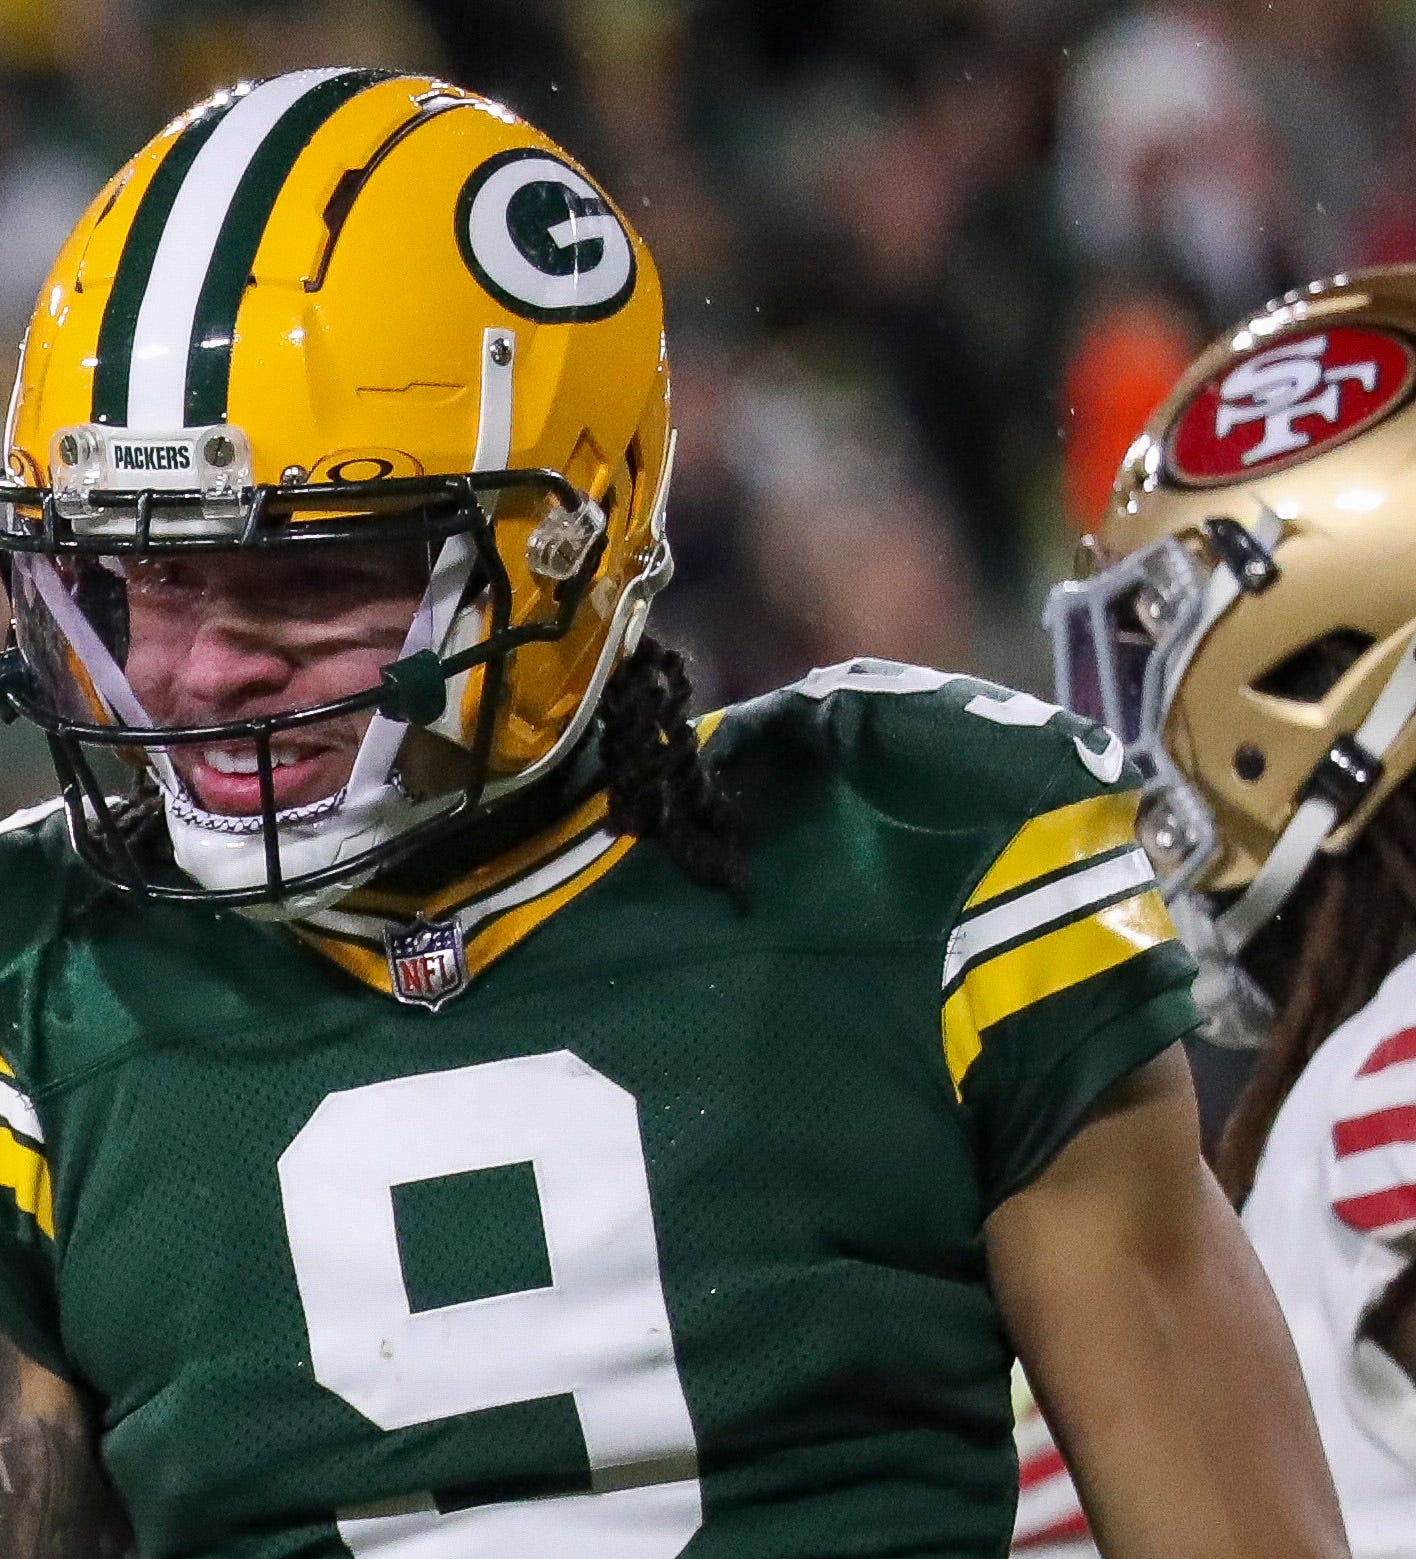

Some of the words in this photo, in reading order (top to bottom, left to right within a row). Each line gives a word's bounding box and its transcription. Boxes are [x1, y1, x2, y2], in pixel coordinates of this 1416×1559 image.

[470, 156, 638, 308] G
[113, 443, 191, 471] PACKERS
[399, 954, 458, 993] NFL
